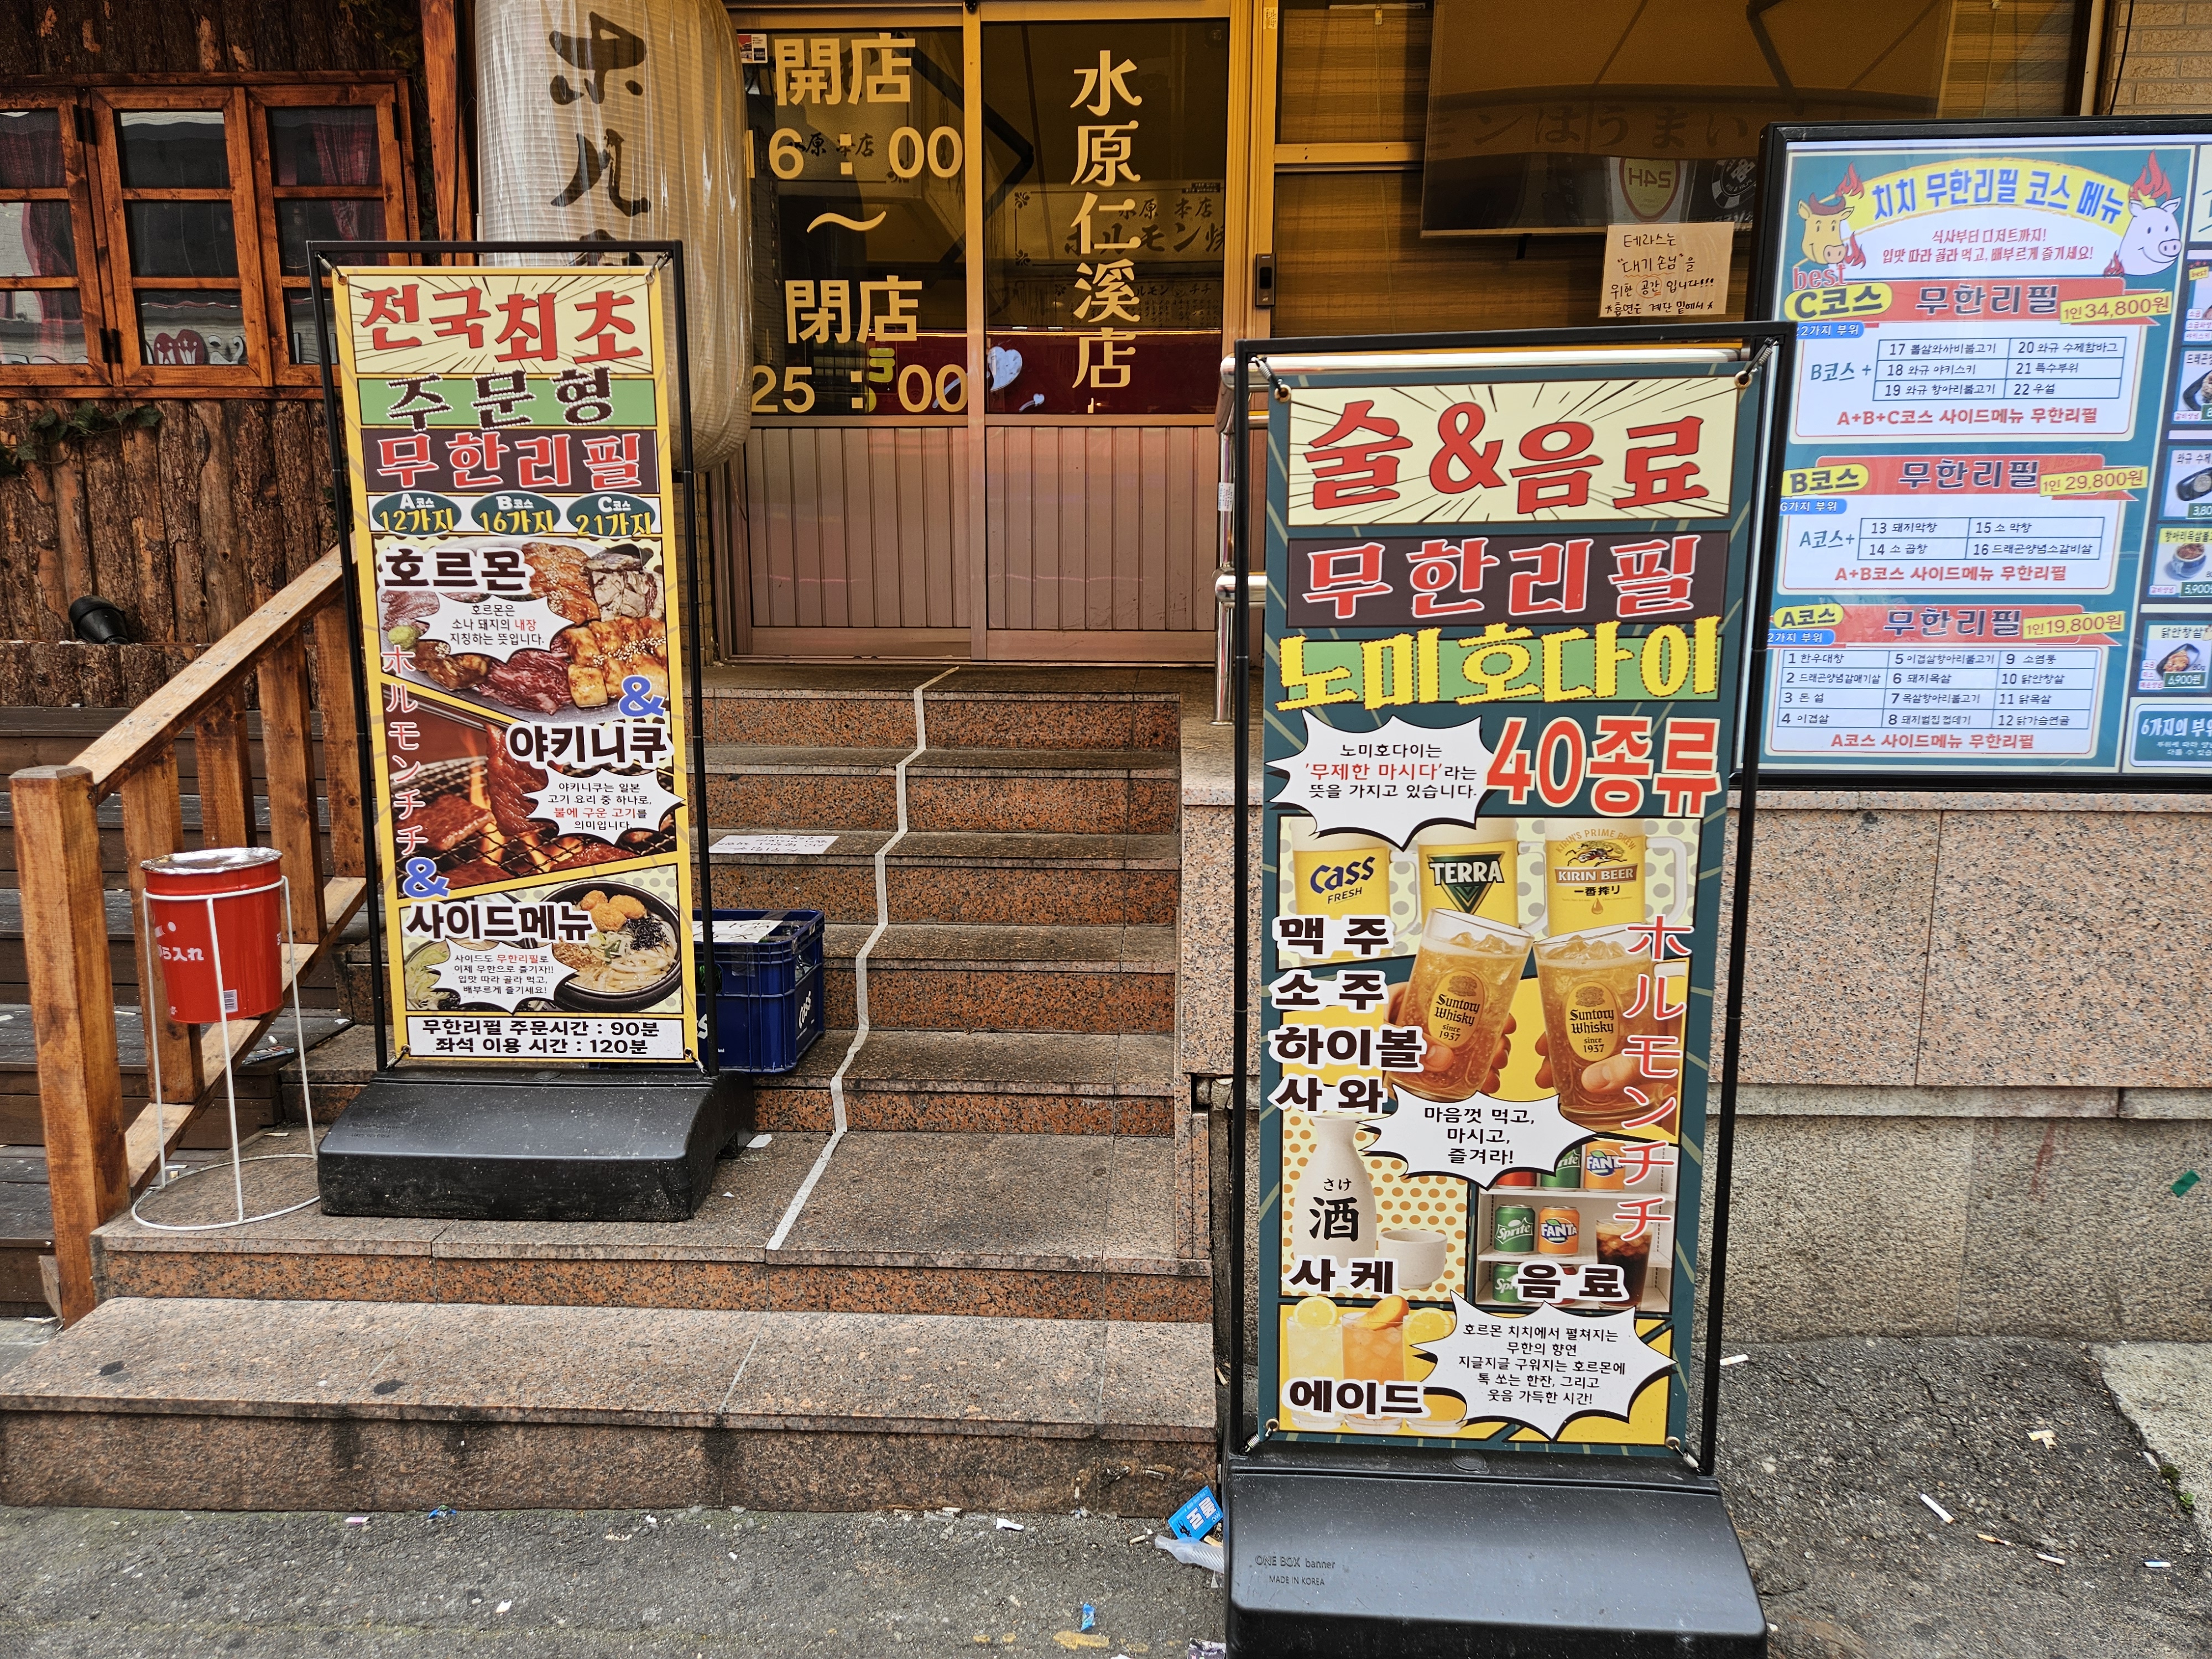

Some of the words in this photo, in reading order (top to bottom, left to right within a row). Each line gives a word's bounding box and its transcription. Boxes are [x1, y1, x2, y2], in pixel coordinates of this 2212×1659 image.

[774, 32, 916, 106] 開店
[1873, 178, 1917, 220] 치치
[1924, 168, 2019, 205] 무한리필
[2028, 169, 2070, 210] 코스
[2077, 179, 2126, 224] 메뉴
[1070, 50, 1143, 389] 水原仁溪店
[1624, 233, 1676, 247] 테라스는
[1932, 228, 1980, 244] 식사부터
[1983, 227, 2047, 244] 디저트까지!
[1882, 249, 1905, 264] 입맛
[1908, 248, 1932, 263] 따라
[1936, 248, 1959, 263] 골라
[1961, 248, 1988, 263] 먹고,
[1991, 247, 2039, 262] 배부르게
[2042, 246, 2094, 261] 즐기세요!
[1792, 265, 1847, 291] best
[1611, 283, 1633, 299] 위한
[1641, 280, 1660, 295] 공간
[785, 275, 922, 343] 閉店
[1648, 302, 1672, 313] 계단
[1677, 301, 1703, 314] 밑에서
[1794, 286, 1883, 319] C코스
[1915, 284, 2058, 316] 무한리필
[361, 284, 644, 363] 전국최초
[1887, 364, 1903, 376] 18
[1908, 365, 1929, 375] 와규
[1933, 364, 1976, 375] 야키스키
[2016, 363, 2031, 374] 21
[2035, 363, 2078, 373] 특수부위
[2013, 384, 2029, 395] 22
[1837, 409, 1933, 426] A+B+C코스
[1939, 407, 2025, 425] 사이드메뉴
[2030, 406, 2098, 424] 무한리필
[377, 432, 642, 491] 무한리필
[1303, 399, 1711, 515] 술&음료
[1790, 469, 1860, 494] B코스
[1897, 458, 2040, 490] 무한리필
[2042, 480, 2060, 493] 1인
[2064, 471, 2143, 490] 29,800원
[399, 493, 434, 510] A코스
[496, 495, 534, 510] B코스
[598, 495, 632, 513] C코스
[378, 509, 453, 534] 12가지
[478, 508, 554, 534] 16가지
[576, 512, 653, 536] 21가지
[1975, 521, 1991, 534] 15
[1994, 522, 2006, 534] 소
[2010, 521, 2032, 534] 막창
[1973, 543, 1989, 555] 16
[1991, 542, 2094, 555] 드래곤양념소갈비살
[384, 547, 526, 592] 호르몬
[1302, 535, 1702, 619] 무한리필
[471, 603, 515, 615] 호르몬은
[1782, 608, 1836, 628] A코스
[451, 619, 474, 630] 소나
[478, 619, 510, 630] 돼지의
[514, 619, 537, 630] 내장
[1884, 608, 2022, 637] 무한리필
[2161, 627, 2203, 638] 닭안창살
[1274, 615, 1722, 711] 노미호다이
[1788, 653, 1796, 664] 1
[1801, 653, 1844, 664] 한우대창
[2006, 654, 2015, 665] 9
[2022, 655, 2057, 665] 소염통
[1893, 673, 1902, 684] 6
[1907, 674, 1952, 684] 돼지목살
[1781, 713, 1791, 724] 4
[1797, 714, 1829, 724] 이겹살
[1998, 714, 2013, 726] 12
[2016, 715, 2070, 726] 닭가슴연골
[381, 644, 429, 857] ホルモンチチ
[509, 725, 667, 764] 야키니쿠
[1340, 744, 1442, 758] 노미호다이는
[1485, 716, 1722, 817] 40종류
[558, 782, 614, 793] 야키니쿠는
[618, 782, 640, 792] 일본
[554, 807, 578, 819] 불에
[582, 807, 608, 819] 구운
[612, 807, 648, 819] 고기를
[574, 820, 633, 831] 의미입니다.
[1554, 831, 1582, 854] KIRIN'S
[1584, 828, 1614, 839] PRIME
[1616, 831, 1636, 852] BREW
[402, 857, 450, 899] &
[1429, 861, 1504, 884] TERRA
[1558, 869, 1597, 881] KIRIN
[1600, 868, 1635, 880] BEER
[1327, 886, 1363, 905] FRESH
[1573, 885, 1621, 896] 一番搾り
[406, 903, 593, 941] 사이드메뉴
[454, 954, 494, 963] 사이드도
[497, 954, 549, 964] 무한리필로
[463, 985, 502, 995] 배부르게
[505, 985, 547, 995] 즐기세요!
[1569, 1006, 1615, 1022] Suntory
[1570, 1020, 1615, 1035] Whisky
[436, 1038, 474, 1053] 좌석
[483, 1038, 521, 1053] 이용
[529, 1039, 568, 1053] 시간
[577, 1041, 581, 1052] :
[590, 1039, 648, 1054] 120분
[1274, 1029, 1422, 1068] 하이볼
[1583, 1044, 1605, 1054] 1937
[1584, 1036, 1603, 1045] since
[1612, 914, 1694, 1243] ホルモンチチ
[1423, 1106, 1485, 1125] 마음껏
[1492, 1107, 1535, 1125] 먹고,
[1447, 1127, 1511, 1146] 마시고,
[1447, 1148, 1515, 1166] 즐겨라!
[1323, 1178, 1352, 1192] さけ
[1308, 1197, 1360, 1243] 酒
[1498, 1223, 1532, 1238] Sprite
[1541, 1223, 1578, 1237] FANTA
[1463, 1324, 1503, 1338] 호르몬
[1508, 1324, 1561, 1340] 치치에서
[1566, 1327, 1619, 1342] 펼쳐지는
[1506, 1342, 1547, 1355] 무한의
[1552, 1342, 1577, 1357] 향연
[1288, 1380, 1424, 1415] 에이드
[1486, 1389, 1514, 1403] 웃음
[1518, 1389, 1558, 1404] 가득한
[1563, 1390, 1593, 1405] 시간!
[1255, 1554, 1277, 1566] ONE
[1280, 1556, 1301, 1568] BOX
[1305, 1558, 1335, 1569] banner
[1269, 1575, 1290, 1584] MADE
[1301, 1577, 1325, 1587] KOREA
